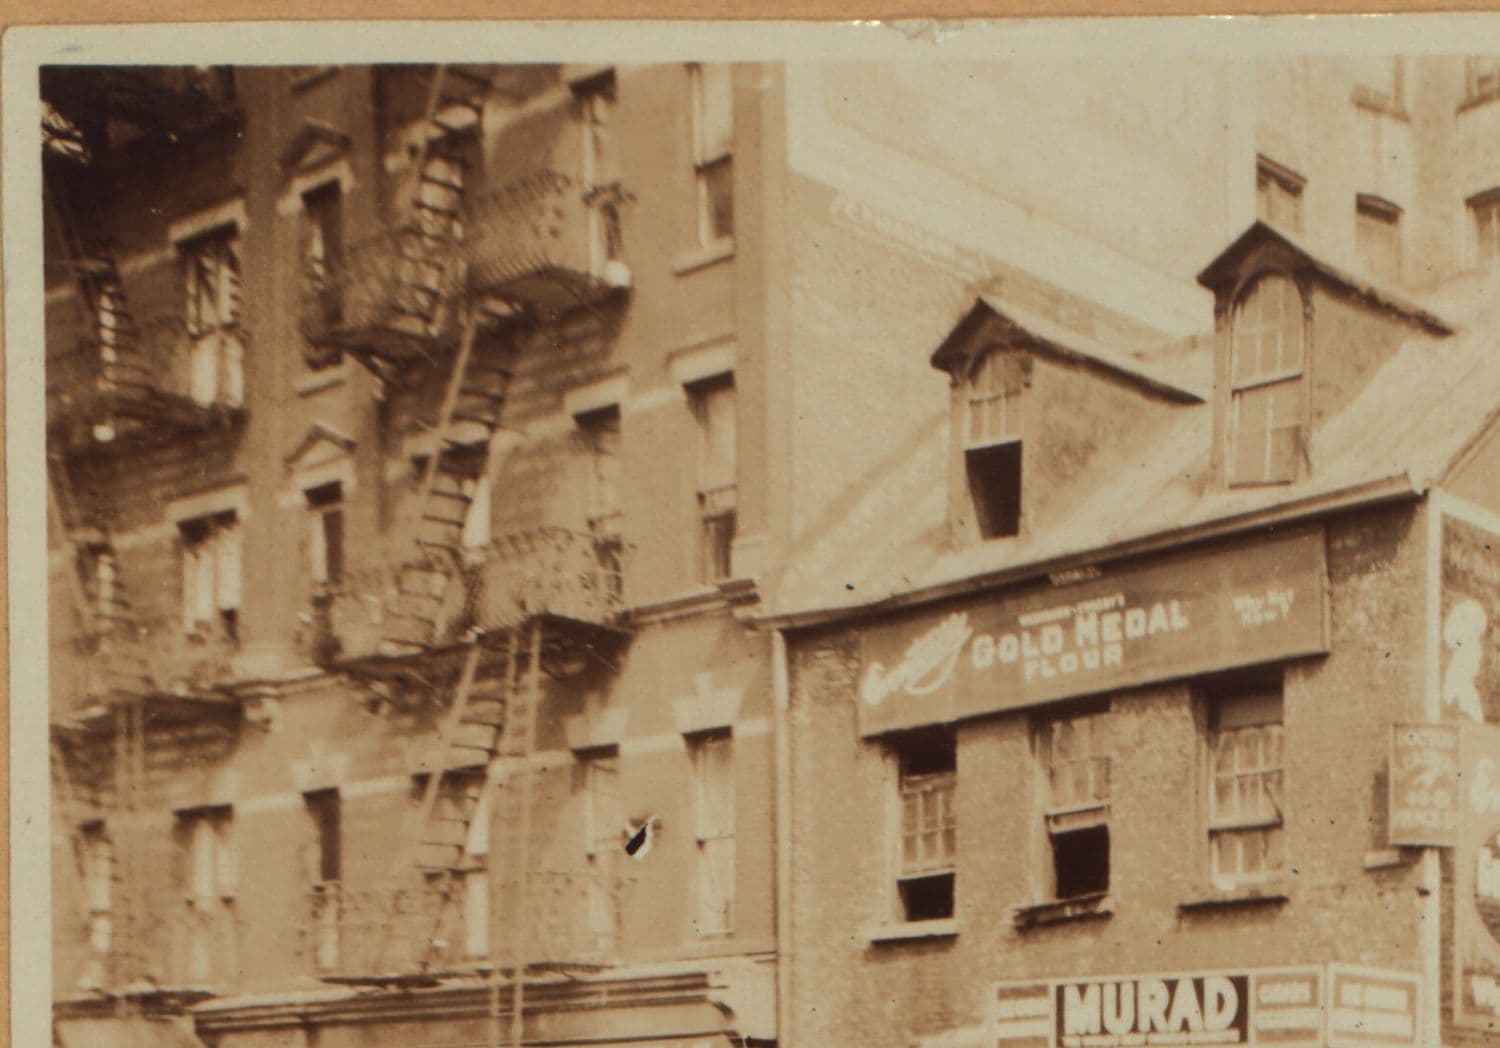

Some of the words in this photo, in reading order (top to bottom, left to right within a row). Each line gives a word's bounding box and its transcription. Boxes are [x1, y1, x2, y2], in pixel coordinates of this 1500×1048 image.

[970, 623, 1064, 669] GOLD
[1074, 599, 1191, 647] MEDAL
[1023, 643, 1124, 682] FLOUR
[1063, 975, 1238, 1037] MURAD
